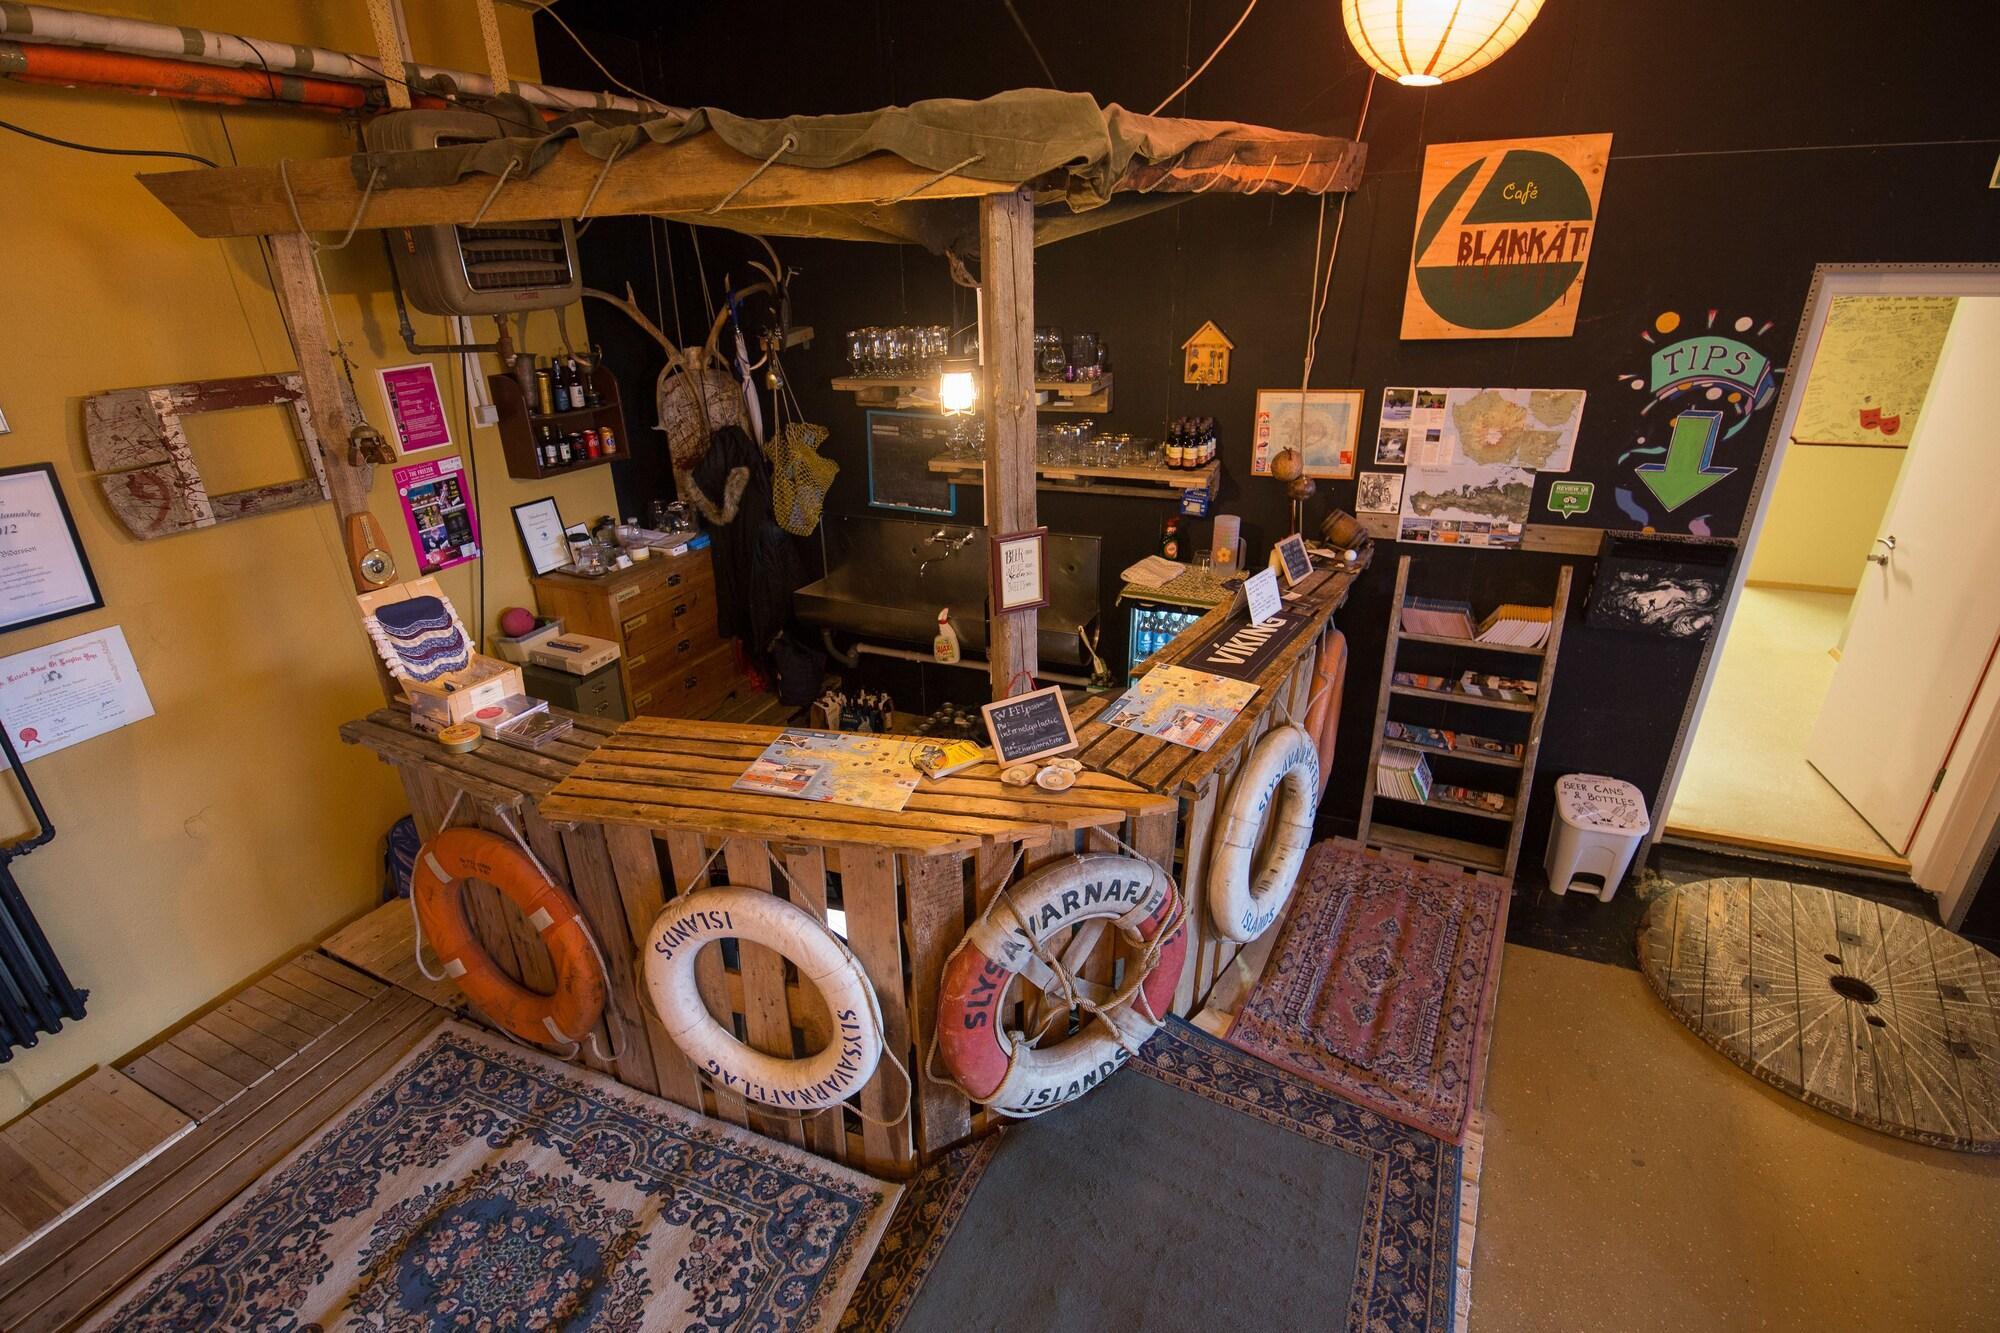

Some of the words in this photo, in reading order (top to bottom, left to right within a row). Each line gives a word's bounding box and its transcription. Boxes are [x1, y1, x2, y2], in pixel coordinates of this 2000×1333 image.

[1503, 181, 1538, 205] Café
[1457, 222, 1589, 264] BLAKKÁT
[1663, 345, 1751, 376] TIPS
[1206, 617, 1288, 665] VÍKING
[1563, 781, 1587, 792] BEER
[1594, 784, 1625, 796] CANS
[1587, 792, 1636, 808] BOTTLES
[655, 910, 734, 960] ISLANDS
[1241, 906, 1275, 934] ISLANDS
[1021, 1048, 1130, 1106] ISLANDS
